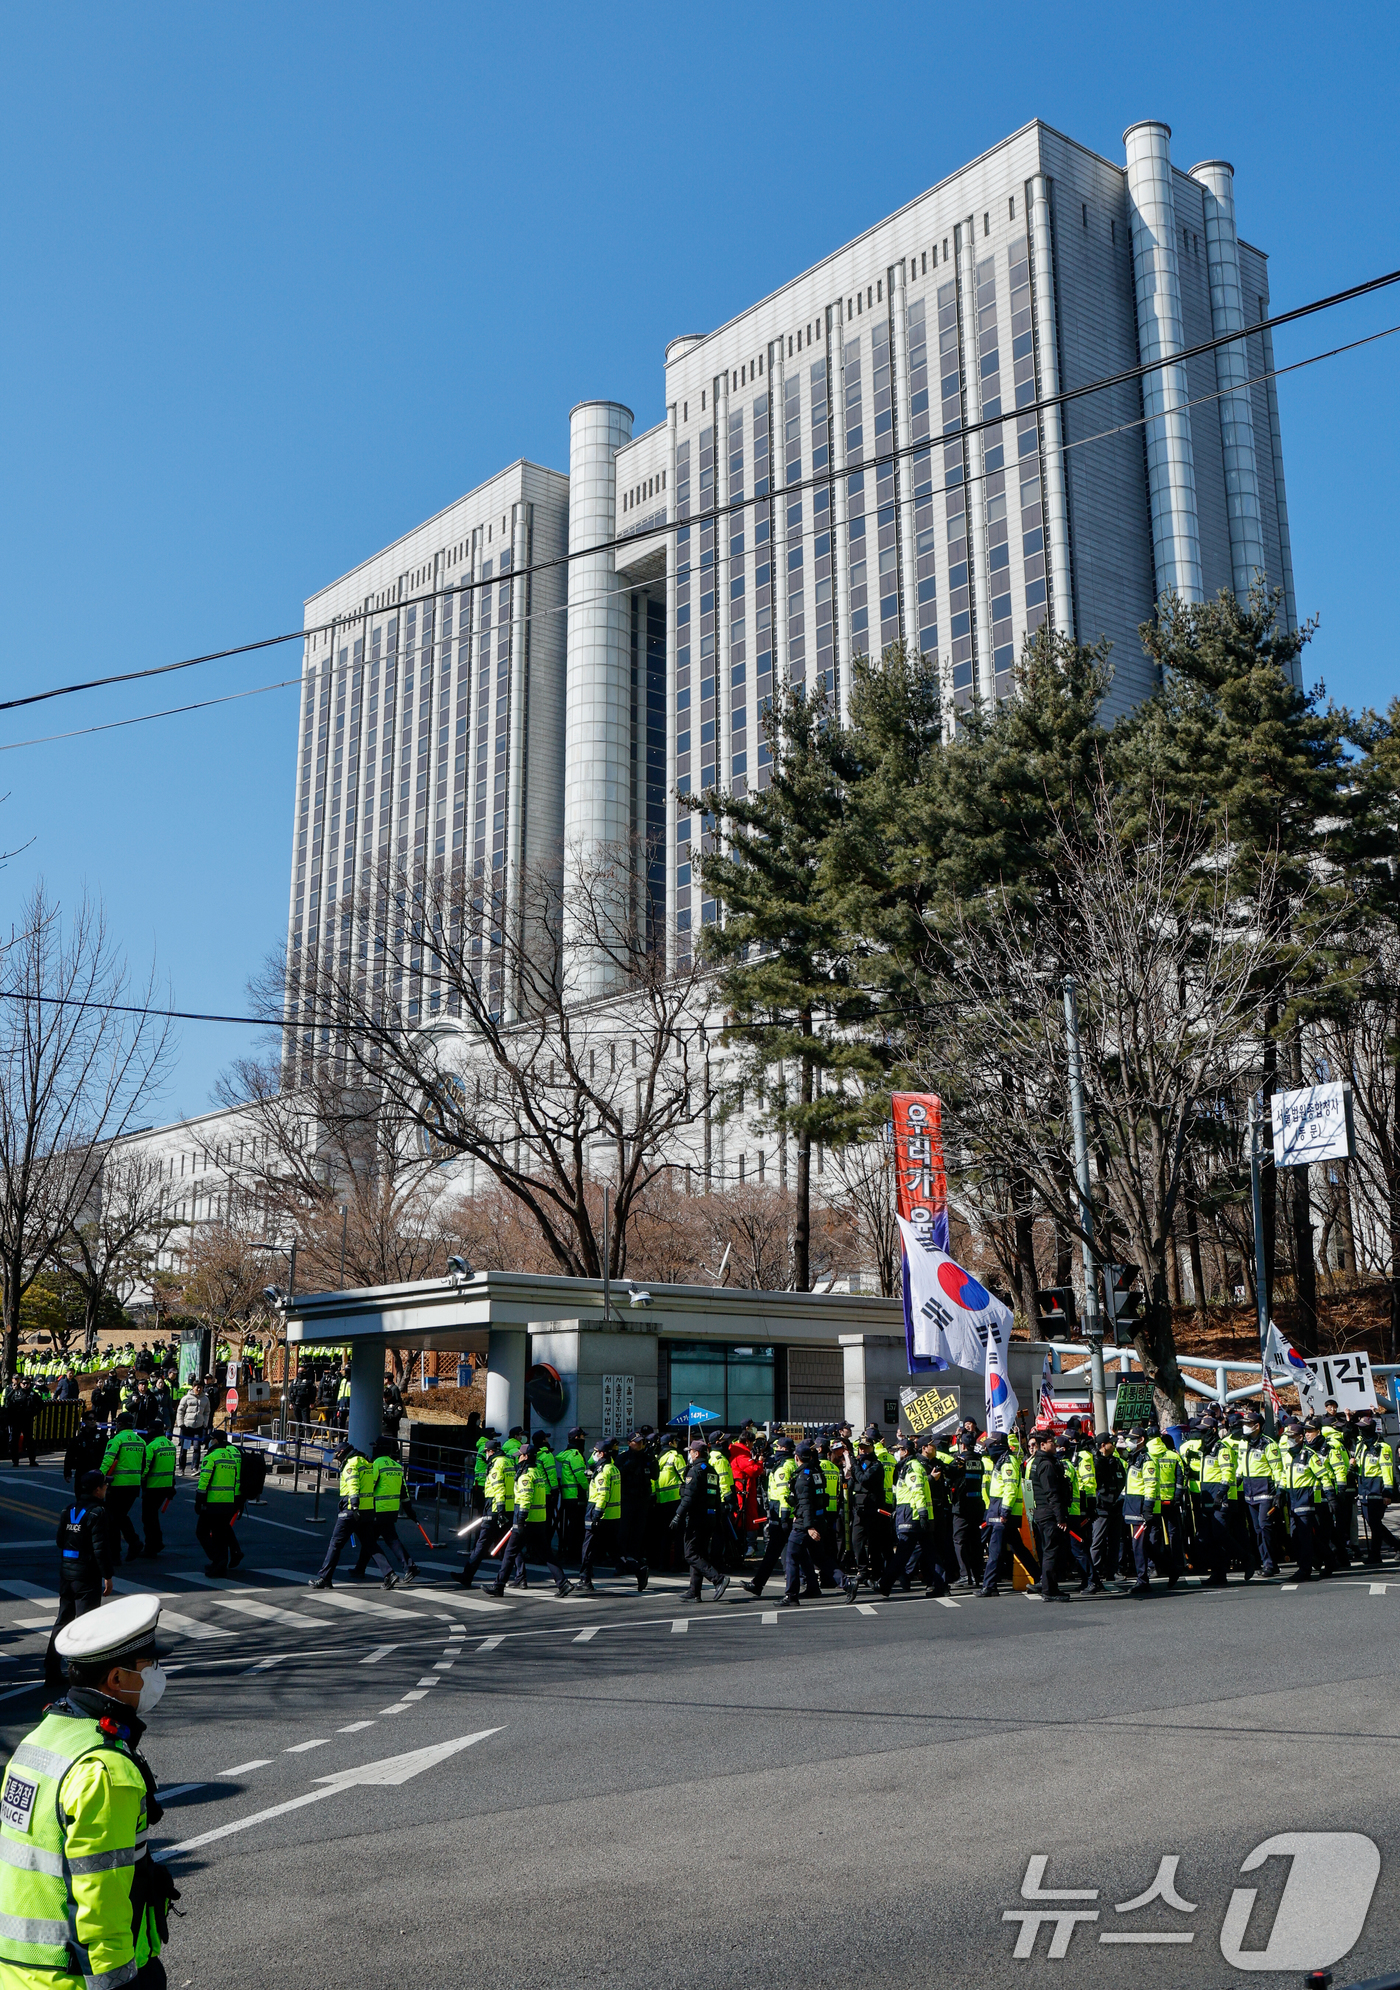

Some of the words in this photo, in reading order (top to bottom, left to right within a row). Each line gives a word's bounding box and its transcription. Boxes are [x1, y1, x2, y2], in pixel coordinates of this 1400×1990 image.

[1276, 1097, 1339, 1128] 서울법원종합청사
[906, 1103, 934, 1199] 우리가
[604, 1376, 612, 1437] 서울회생법원
[690, 1411, 709, 1419] 14기-1
[886, 1402, 897, 1411] 157
[905, 1390, 939, 1417] 계엄은
[912, 1396, 956, 1431] 정당했다
